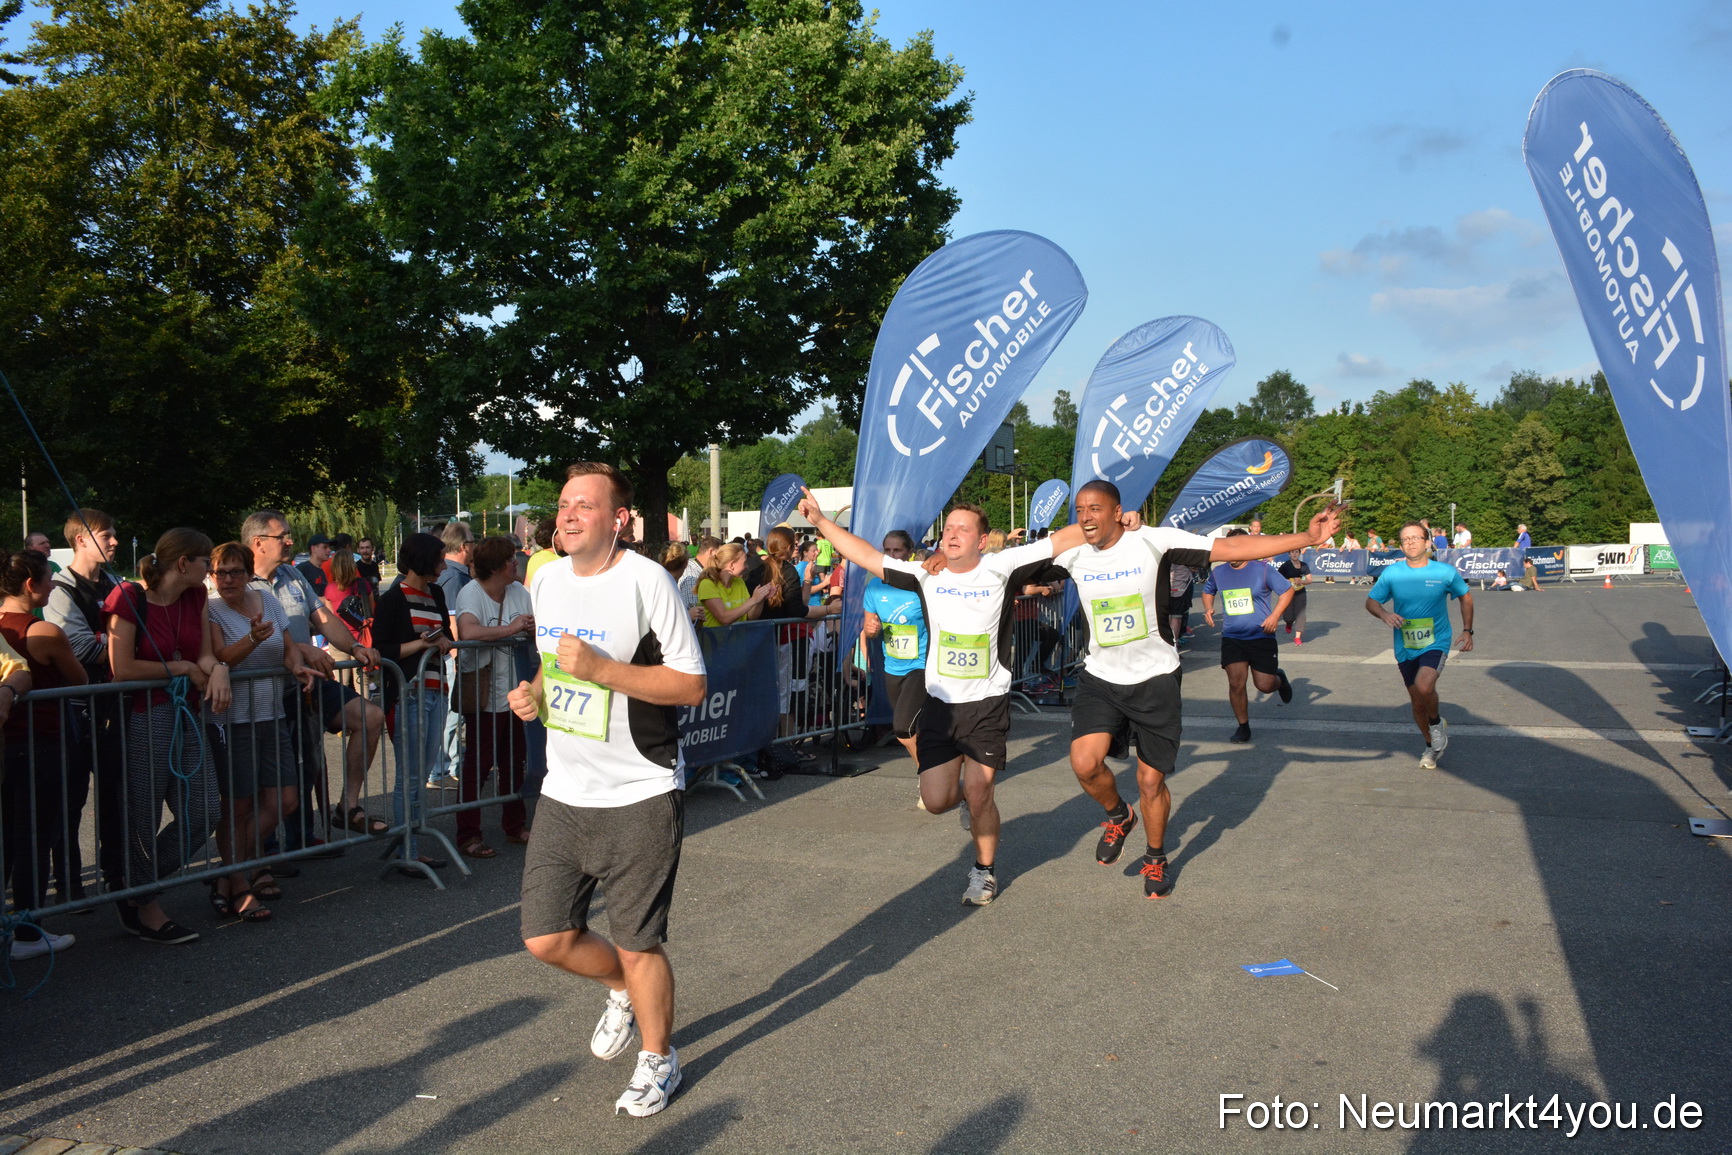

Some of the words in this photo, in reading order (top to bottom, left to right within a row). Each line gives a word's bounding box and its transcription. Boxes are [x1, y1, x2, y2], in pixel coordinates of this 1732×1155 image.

[916, 269, 1038, 430] Fischer
[958, 300, 1052, 429] AUTOMOBILE
[1112, 341, 1198, 462] Fischer
[1142, 362, 1210, 460] AUTOMOBILE
[1225, 492, 1247, 507] Druck
[1247, 485, 1261, 495] und
[1260, 470, 1286, 490] Medien
[771, 482, 797, 519] Fischer
[1039, 486, 1061, 518] Fischer
[1169, 476, 1257, 528] Frischmann
[1597, 552, 1626, 566] swn
[1654, 549, 1674, 561] AOK
[1321, 560, 1354, 569] Fischer
[1465, 561, 1511, 570] Fischer
[1083, 567, 1142, 582] DELPHI
[936, 587, 990, 599] DELPHI
[1228, 598, 1249, 609] 1667
[1103, 614, 1135, 632] 279
[889, 637, 909, 650] 817
[1405, 629, 1431, 641] 1104
[947, 651, 979, 667] 283
[549, 685, 593, 716] 277
[681, 723, 728, 748] MOBILE
